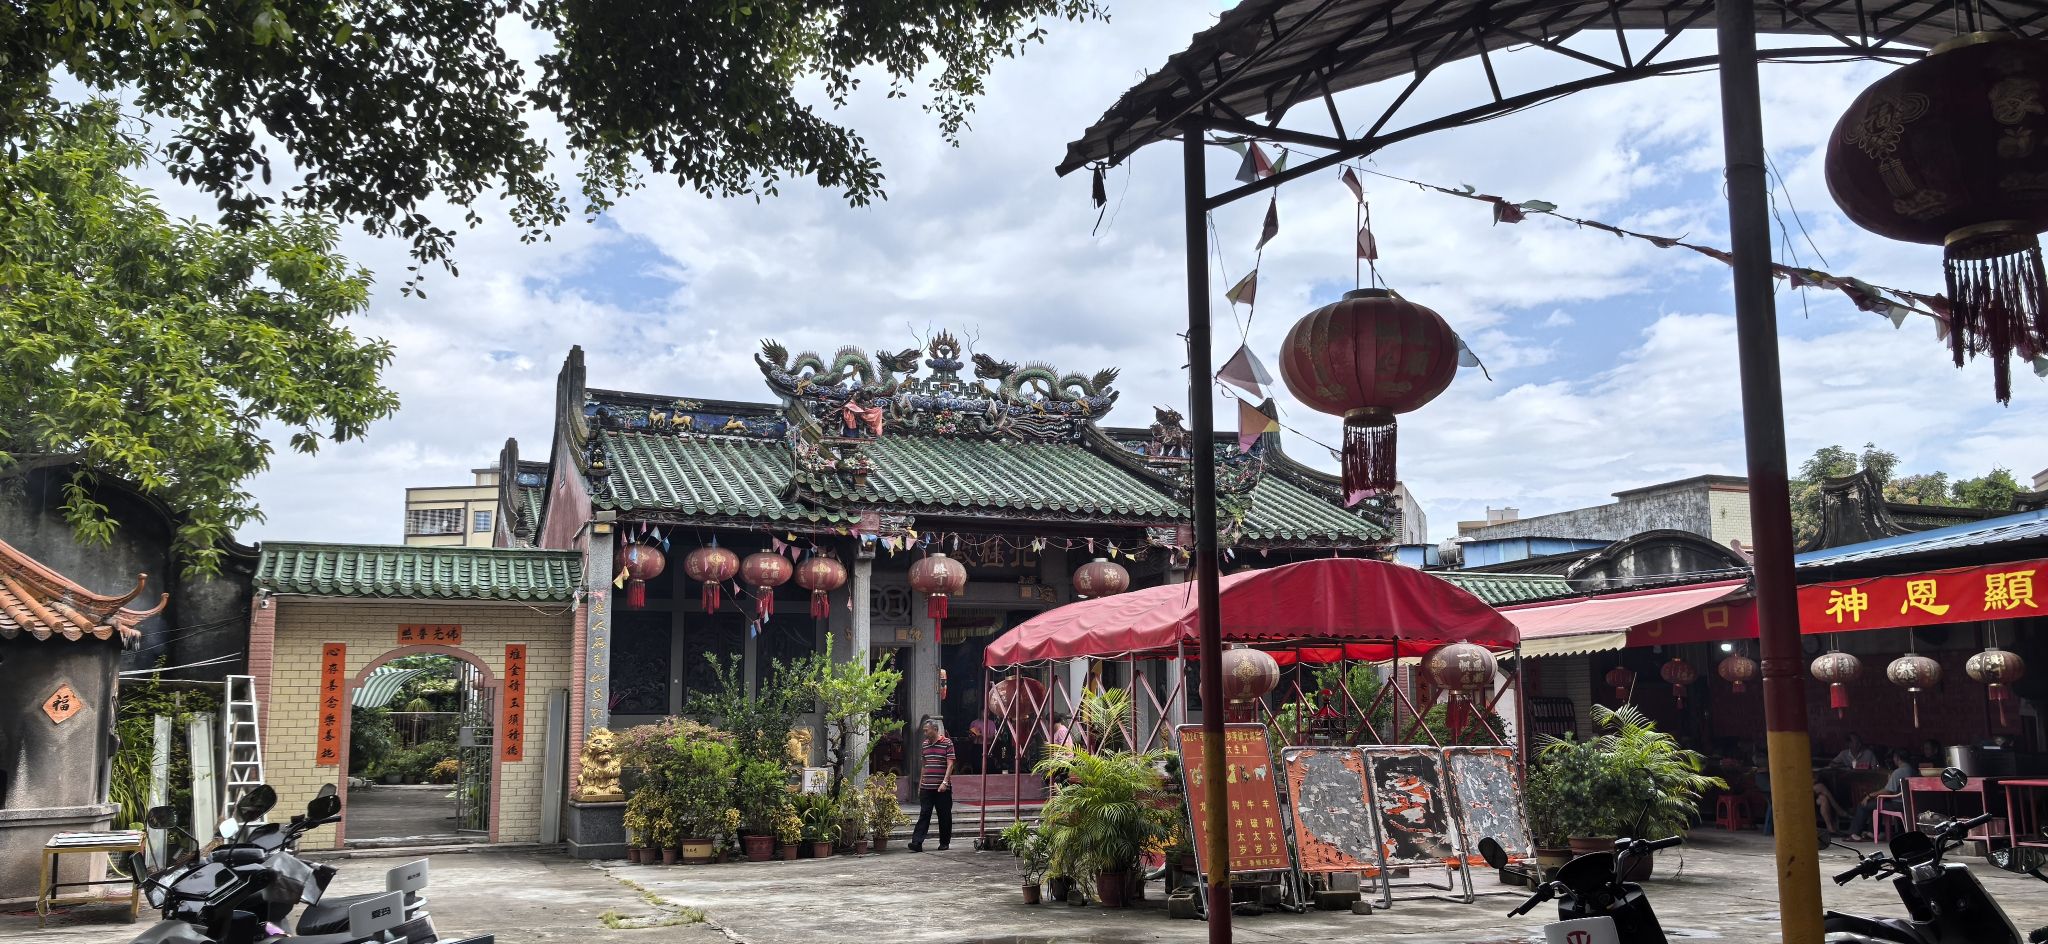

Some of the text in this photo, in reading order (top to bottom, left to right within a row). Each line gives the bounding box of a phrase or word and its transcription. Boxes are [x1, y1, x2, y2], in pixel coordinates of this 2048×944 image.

[1825, 570, 2039, 624] 神恩顯
[52, 694, 70, 711] 福
